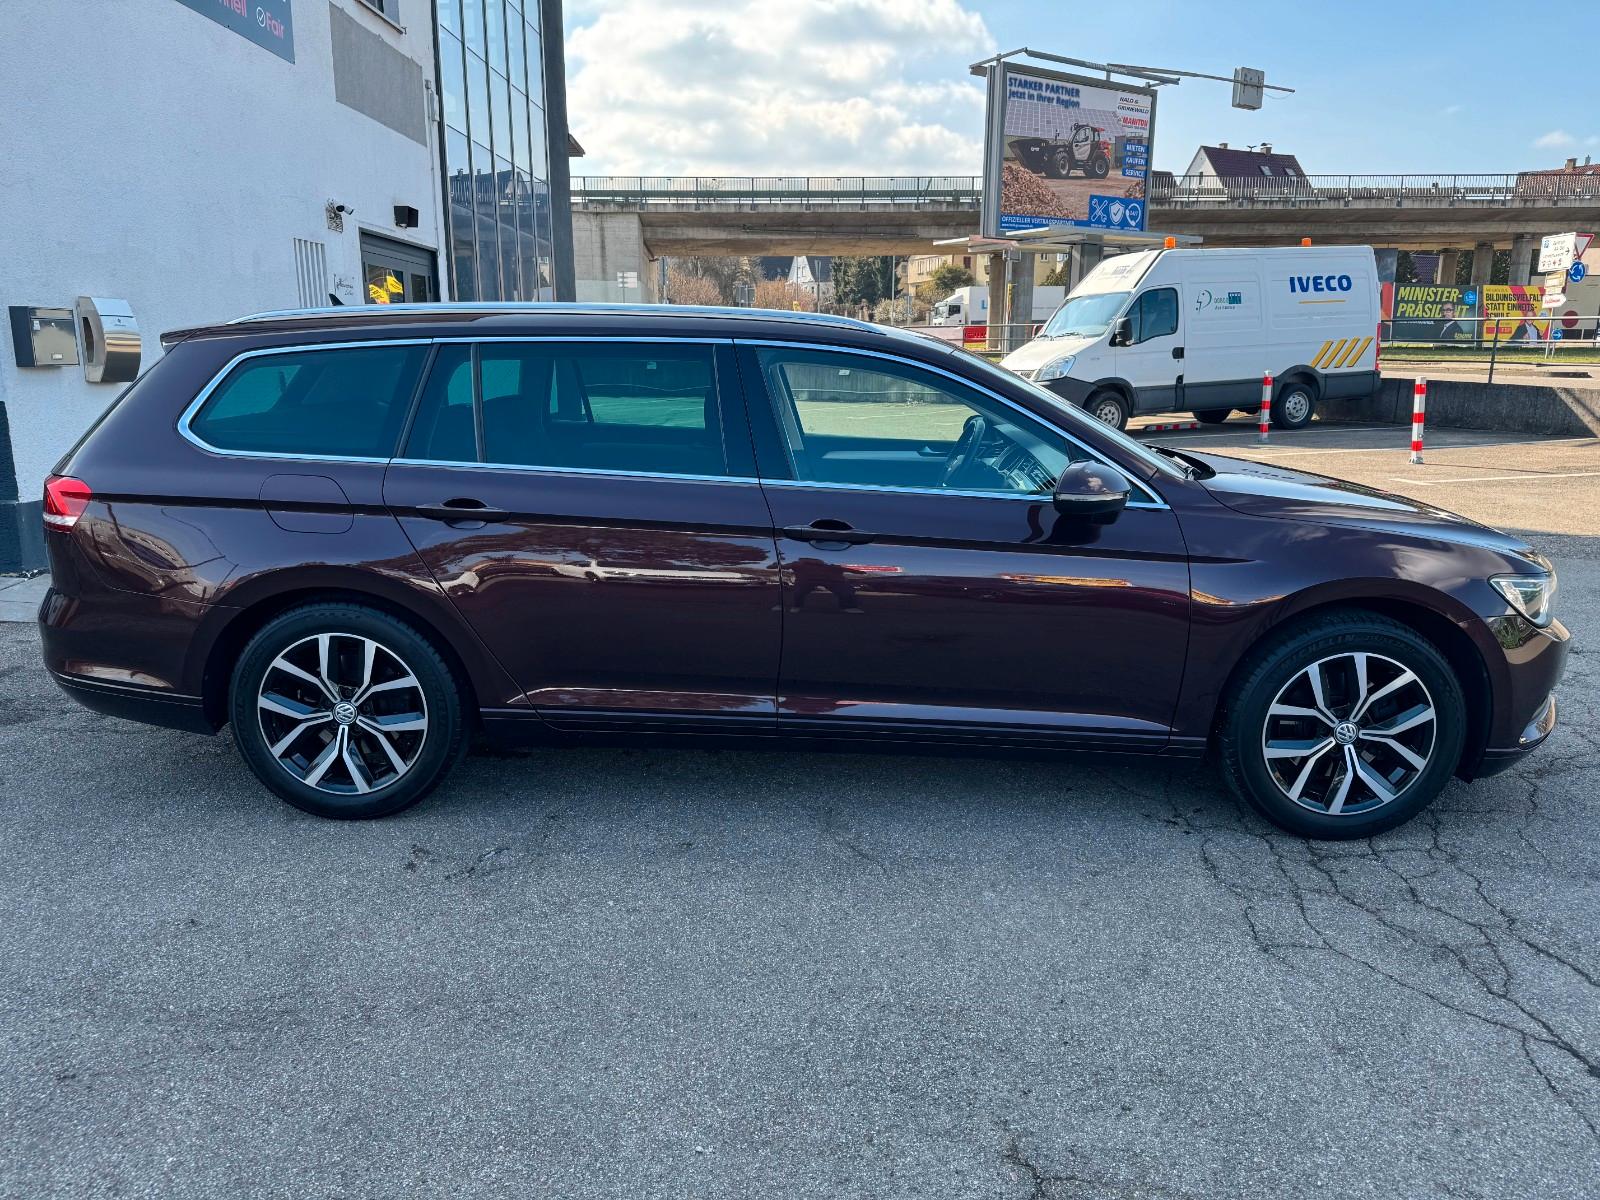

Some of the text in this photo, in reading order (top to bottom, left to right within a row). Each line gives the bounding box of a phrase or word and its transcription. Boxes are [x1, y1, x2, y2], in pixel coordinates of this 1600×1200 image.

[265, 11, 284, 40] Fair
[1008, 77, 1080, 98] STARKER PARTNER
[1027, 91, 1035, 100] in
[1036, 93, 1055, 104] Ihrer
[1056, 96, 1080, 109] Region
[1126, 144, 1145, 153] MIETEN
[1125, 157, 1145, 166] KAUFEN
[1125, 169, 1145, 178] SERVICE
[1001, 216, 1031, 224] OFFIZIELLER
[1289, 274, 1353, 293] IVECO
[1397, 286, 1463, 303] MINISTER-
[1485, 303, 1538, 312] STATT EINHEITS-
